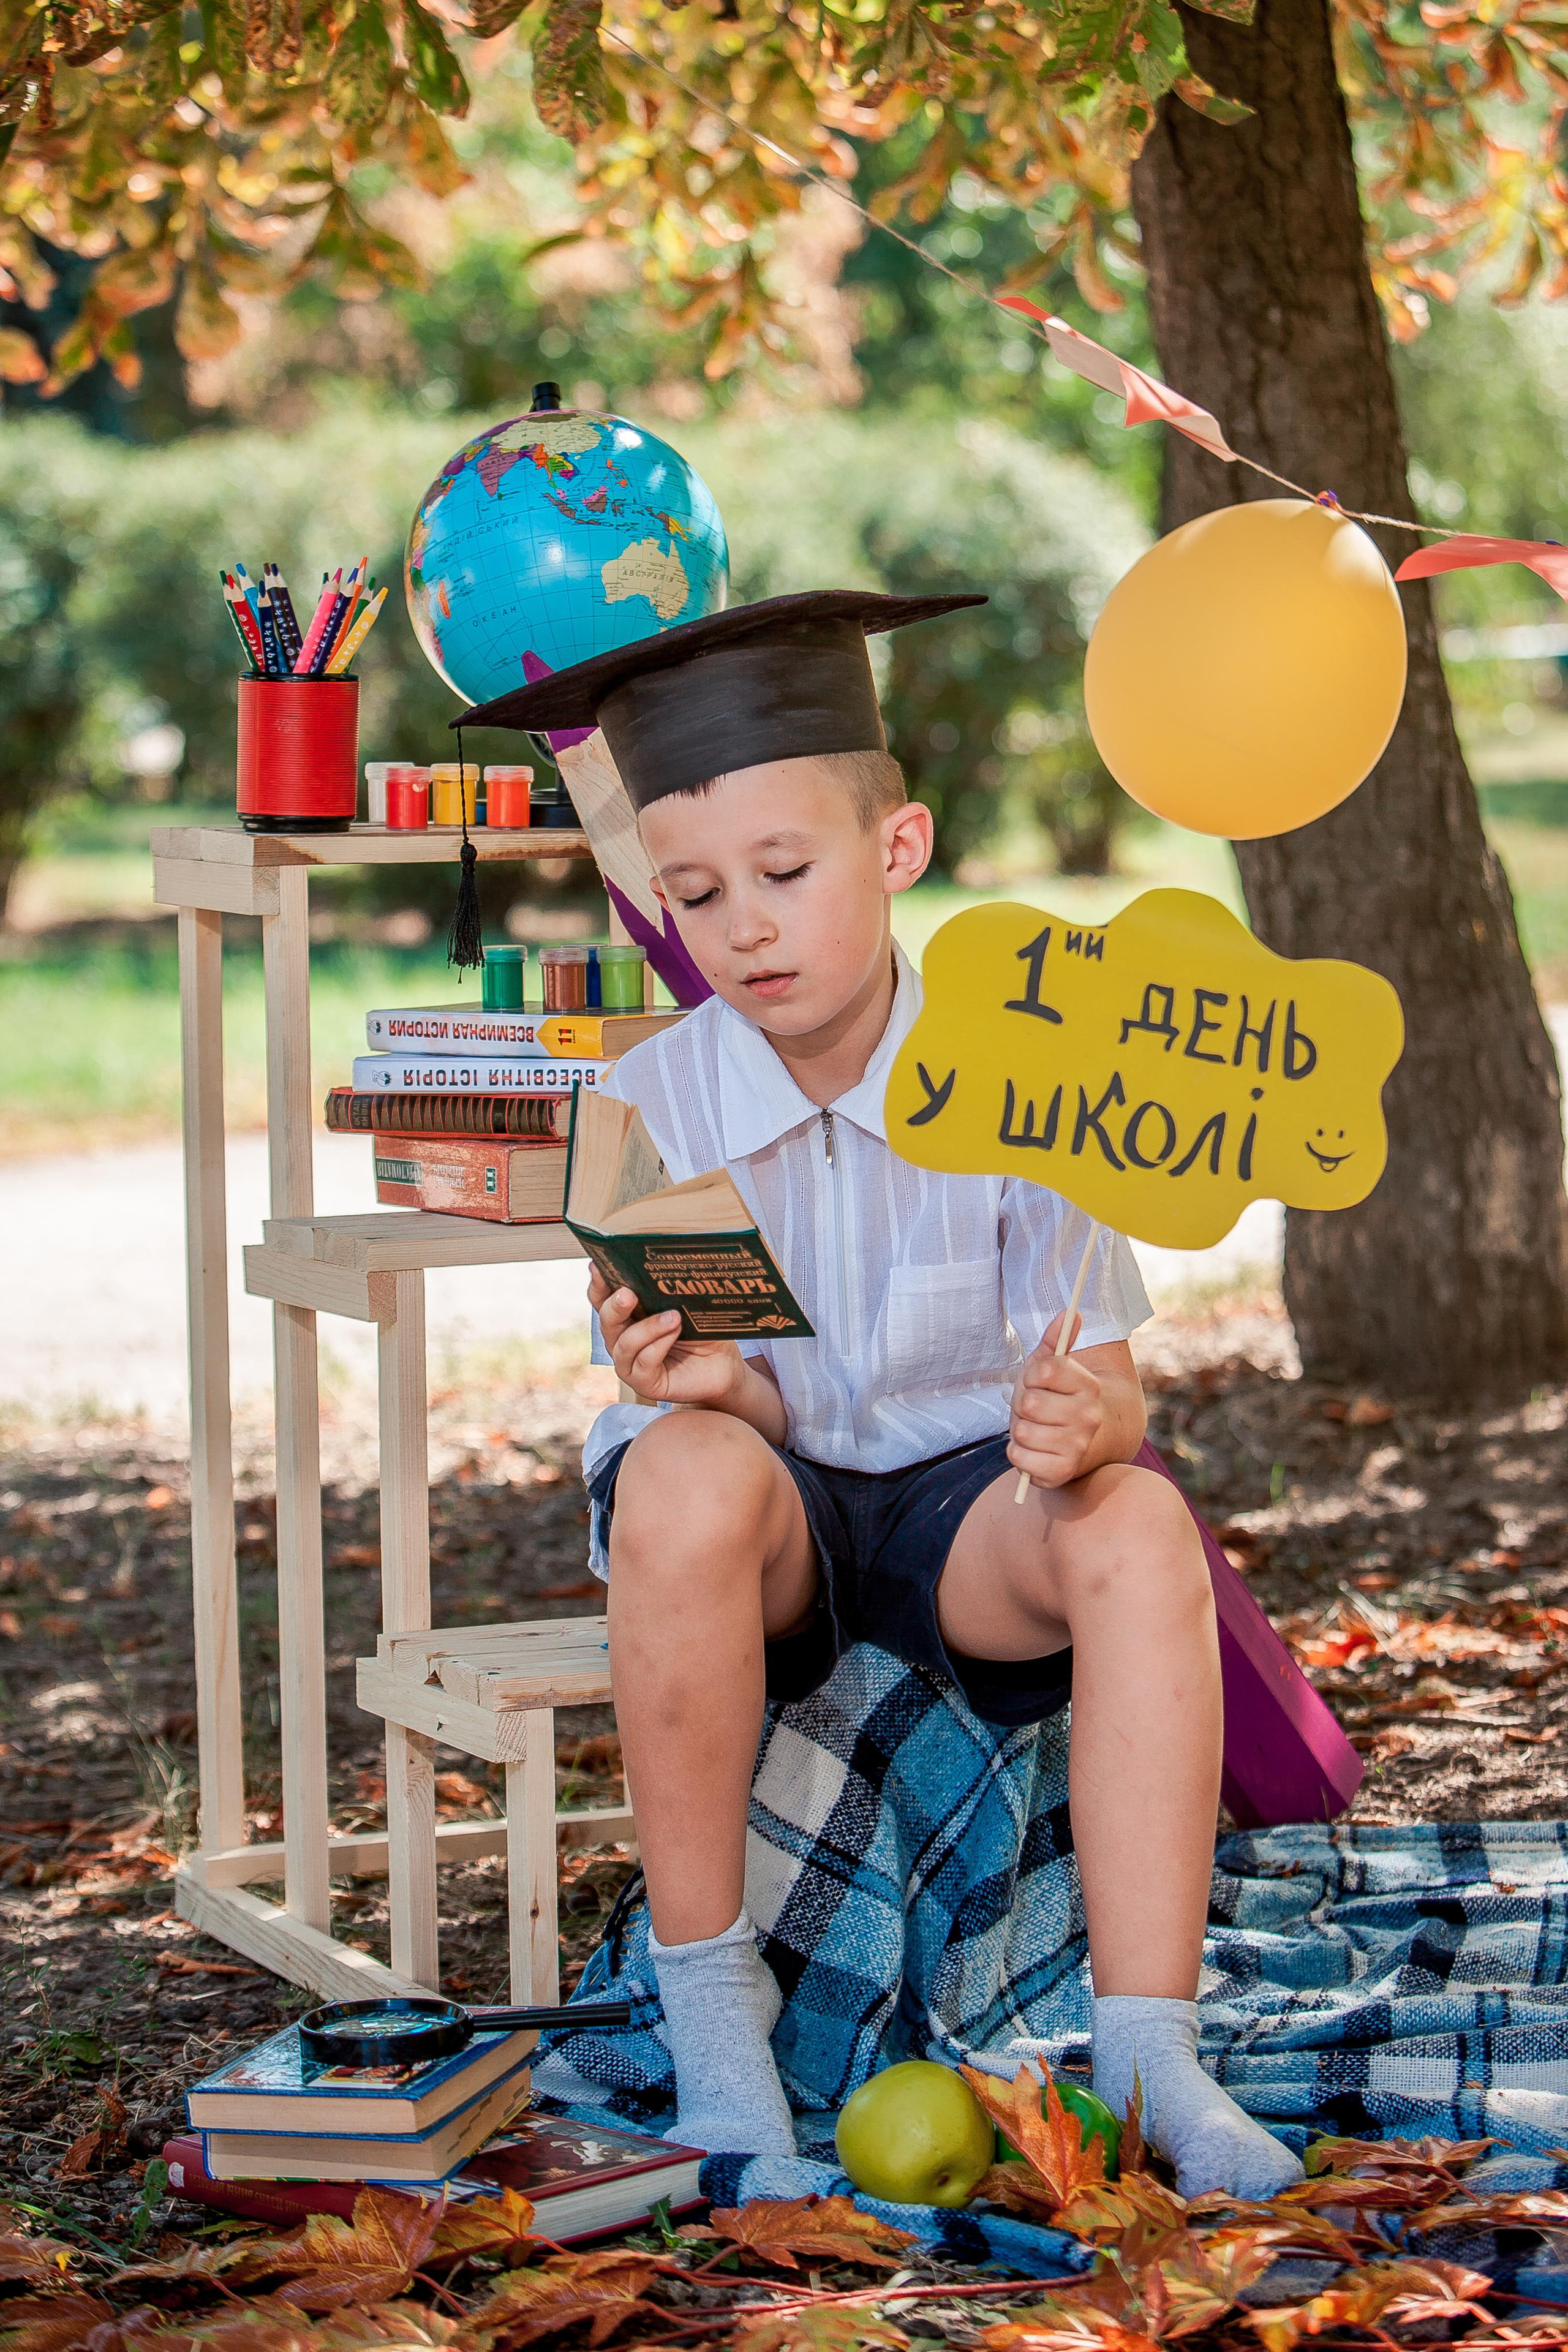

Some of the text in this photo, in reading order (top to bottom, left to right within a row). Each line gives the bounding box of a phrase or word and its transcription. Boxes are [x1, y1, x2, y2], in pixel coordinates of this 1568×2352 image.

[622, 570, 674, 583] АВСТРАЛІЯ
[472, 605, 517, 628] ОКЕАН
[388, 1019, 535, 1044] ВСЕМИРНАЯ ИСТОРИЯ
[1119, 982, 1317, 1081] ДЕНЬ
[403, 1068, 596, 1087] ВСЕСВІТНЯ ІСТОРІЯ
[998, 1069, 1264, 1181] ШКОЛІ
[646, 1250, 752, 1262] Современный
[657, 1278, 777, 1295] СЛОВАРЬ
